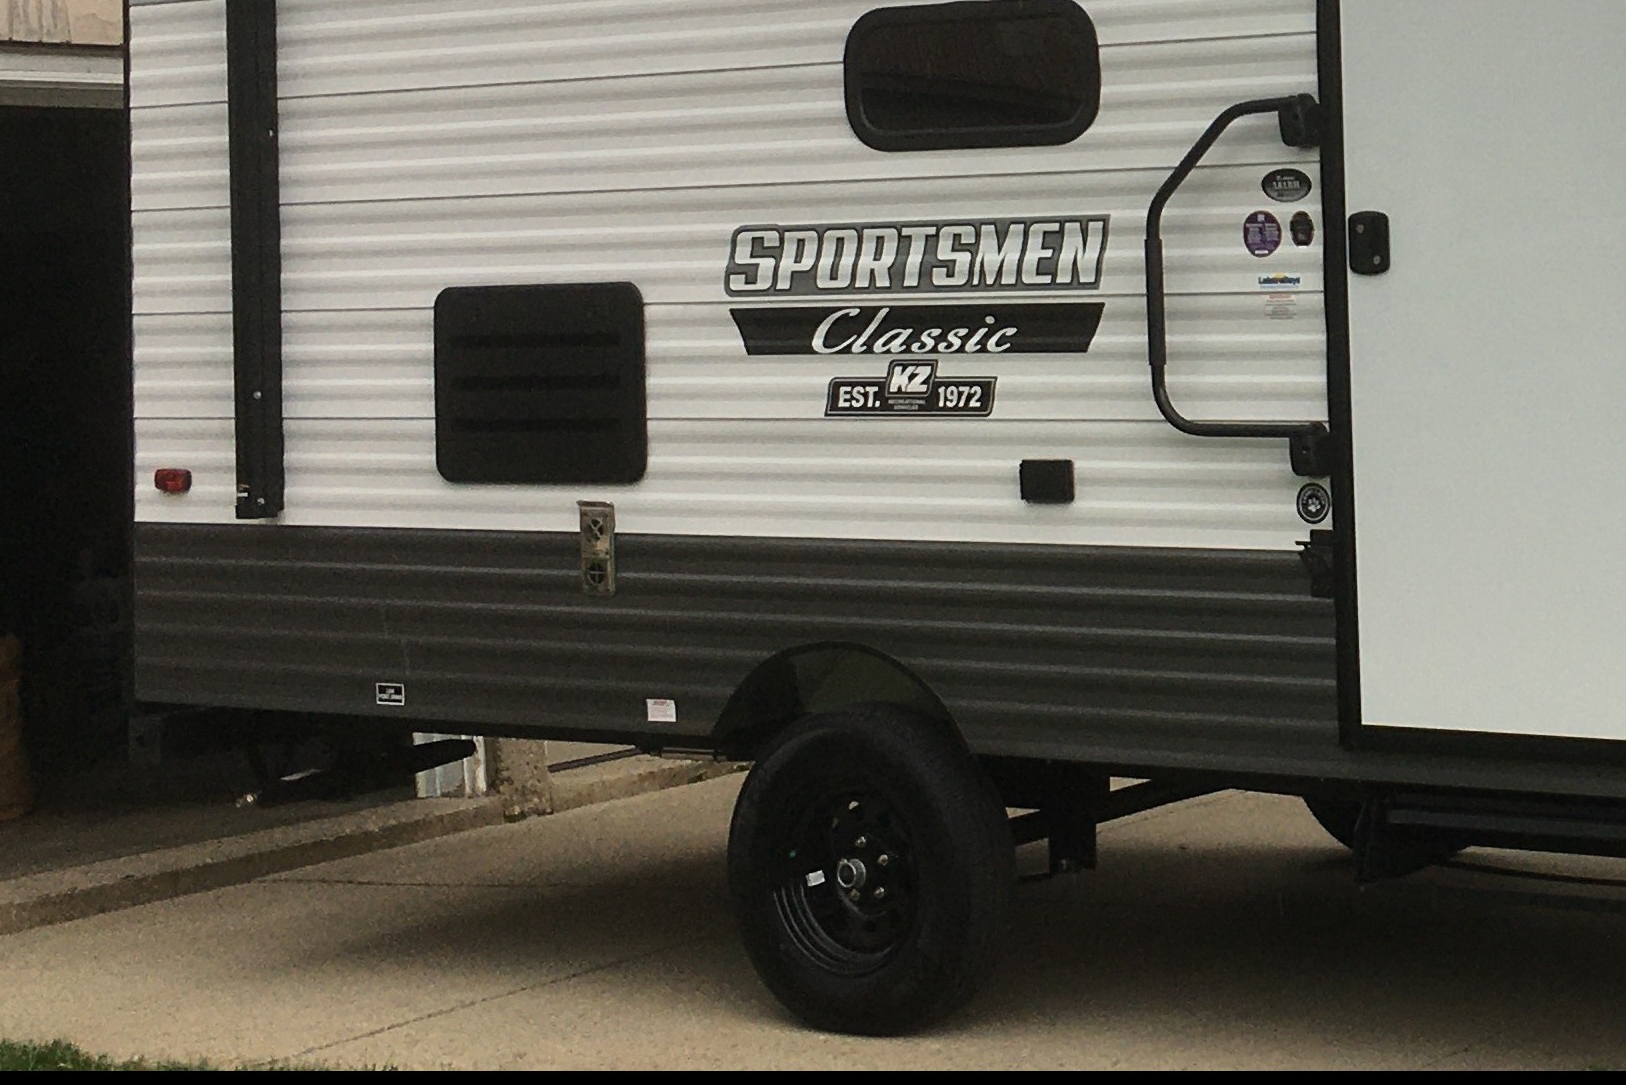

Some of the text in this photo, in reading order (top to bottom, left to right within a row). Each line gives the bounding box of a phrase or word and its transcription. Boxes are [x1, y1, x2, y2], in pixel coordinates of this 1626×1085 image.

[728, 220, 1104, 291] SPORTSMEN
[811, 308, 1018, 354] Classic
[837, 385, 982, 408] EST. 1972
[889, 365, 932, 393] KZ
